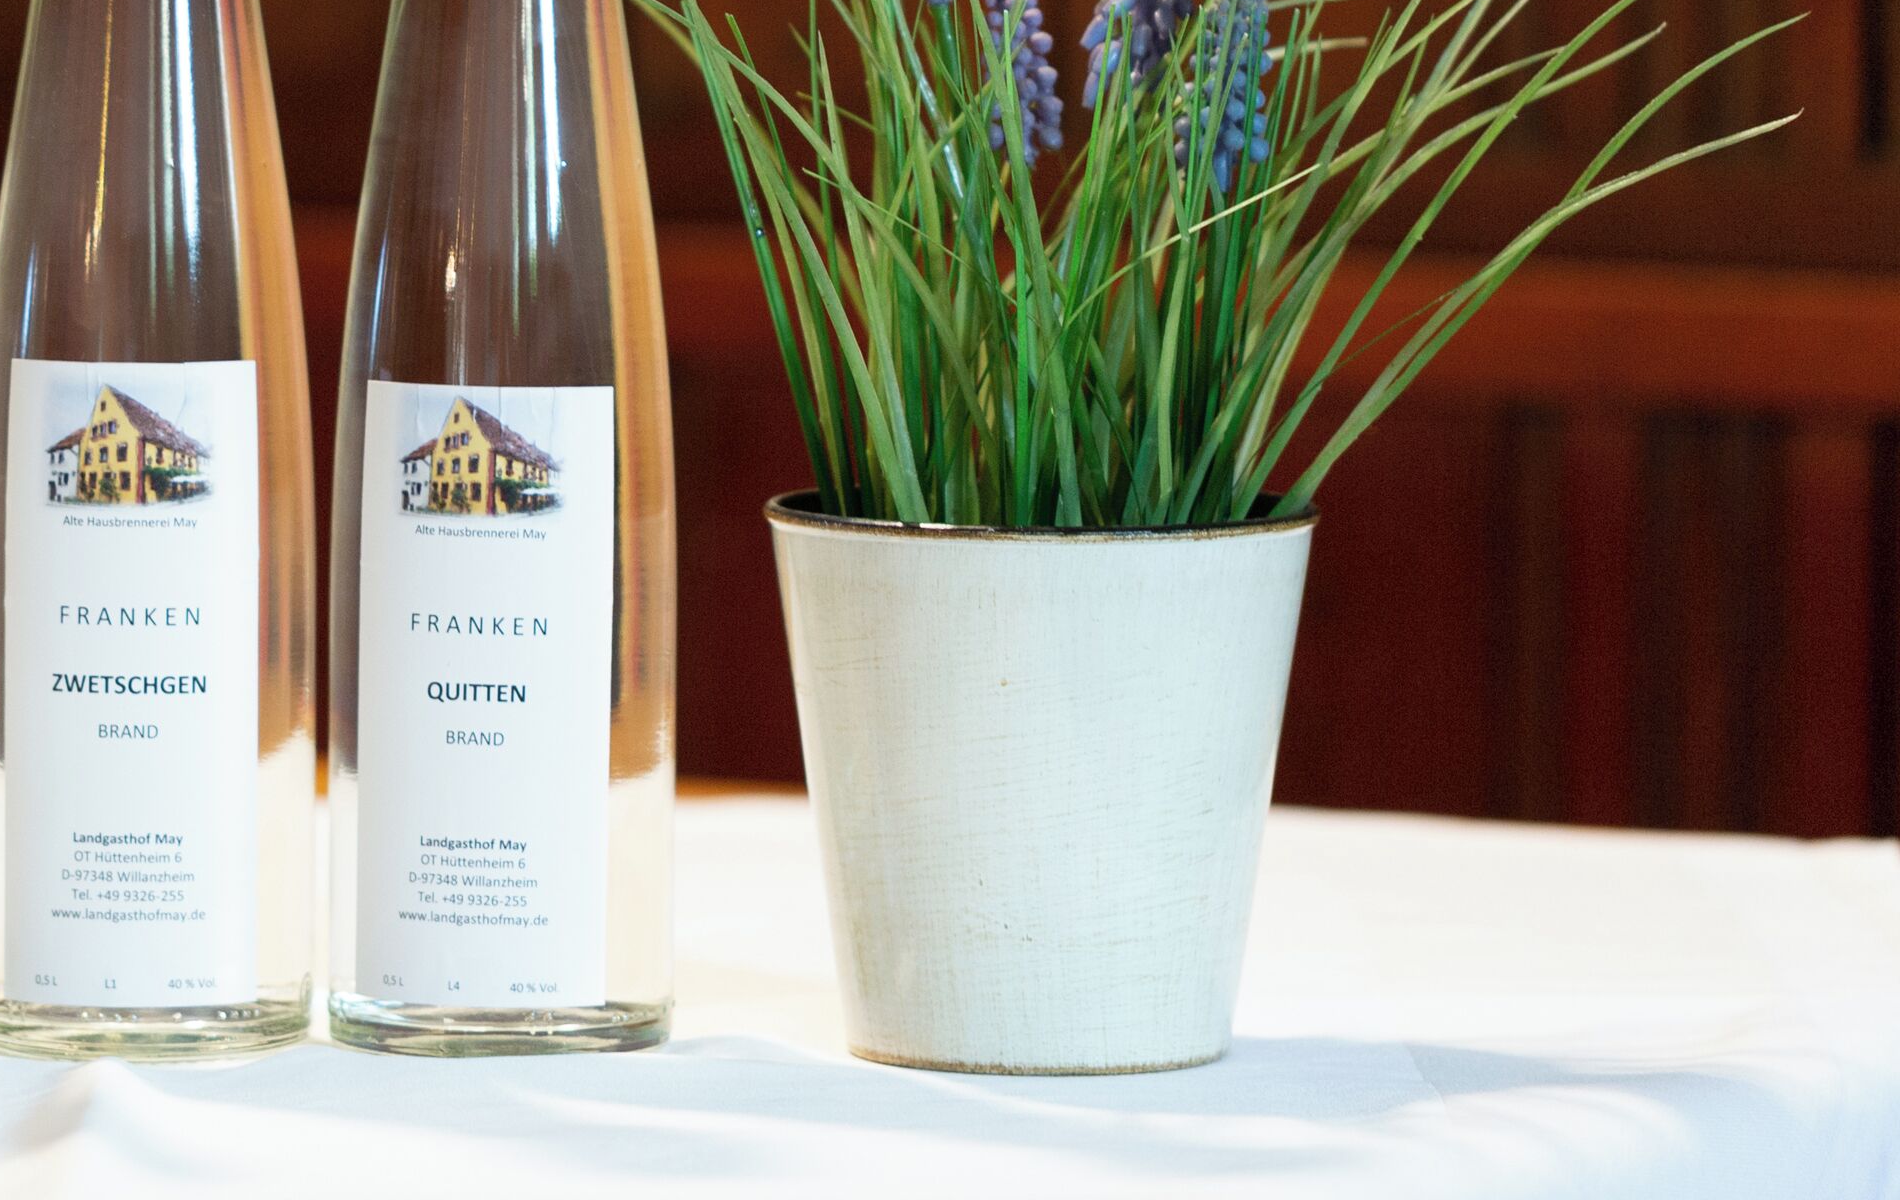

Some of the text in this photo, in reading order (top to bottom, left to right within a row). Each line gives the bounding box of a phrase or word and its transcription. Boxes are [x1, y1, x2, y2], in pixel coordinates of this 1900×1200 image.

[62, 514, 198, 529] Alte Hausbrennerei May
[414, 524, 547, 541] Alte Hausbrennerei May
[60, 605, 200, 627] FRANKEN
[411, 612, 548, 636] FRANKEN
[52, 673, 207, 695] ZWETSCHGEN
[427, 681, 526, 703] QUITTEN
[98, 723, 159, 740] BRAND
[445, 729, 505, 747] BRAND
[72, 831, 184, 847] Landgasthof May
[420, 835, 527, 853] Landgasthof May
[73, 849, 183, 864] OT Hüttenheim 6
[420, 853, 526, 870] OT Hüttenheim 6
[61, 868, 195, 883] D-97348 Willanzheim
[408, 871, 538, 889] D-97348 Willanzheim
[71, 887, 185, 903] Tel. +49 9326-255
[417, 890, 528, 908] Tel. +49 9326-255
[50, 907, 206, 924] www.landgasthofmay.de
[398, 910, 549, 929] www.landgasthofmay.de
[34, 973, 50, 987] 0,5
[104, 978, 117, 990] L1
[167, 978, 183, 990] 40
[184, 978, 196, 990] %
[382, 973, 396, 987] 0,5
[447, 980, 461, 992] L4
[509, 982, 525, 994] 40
[525, 982, 537, 994] %
